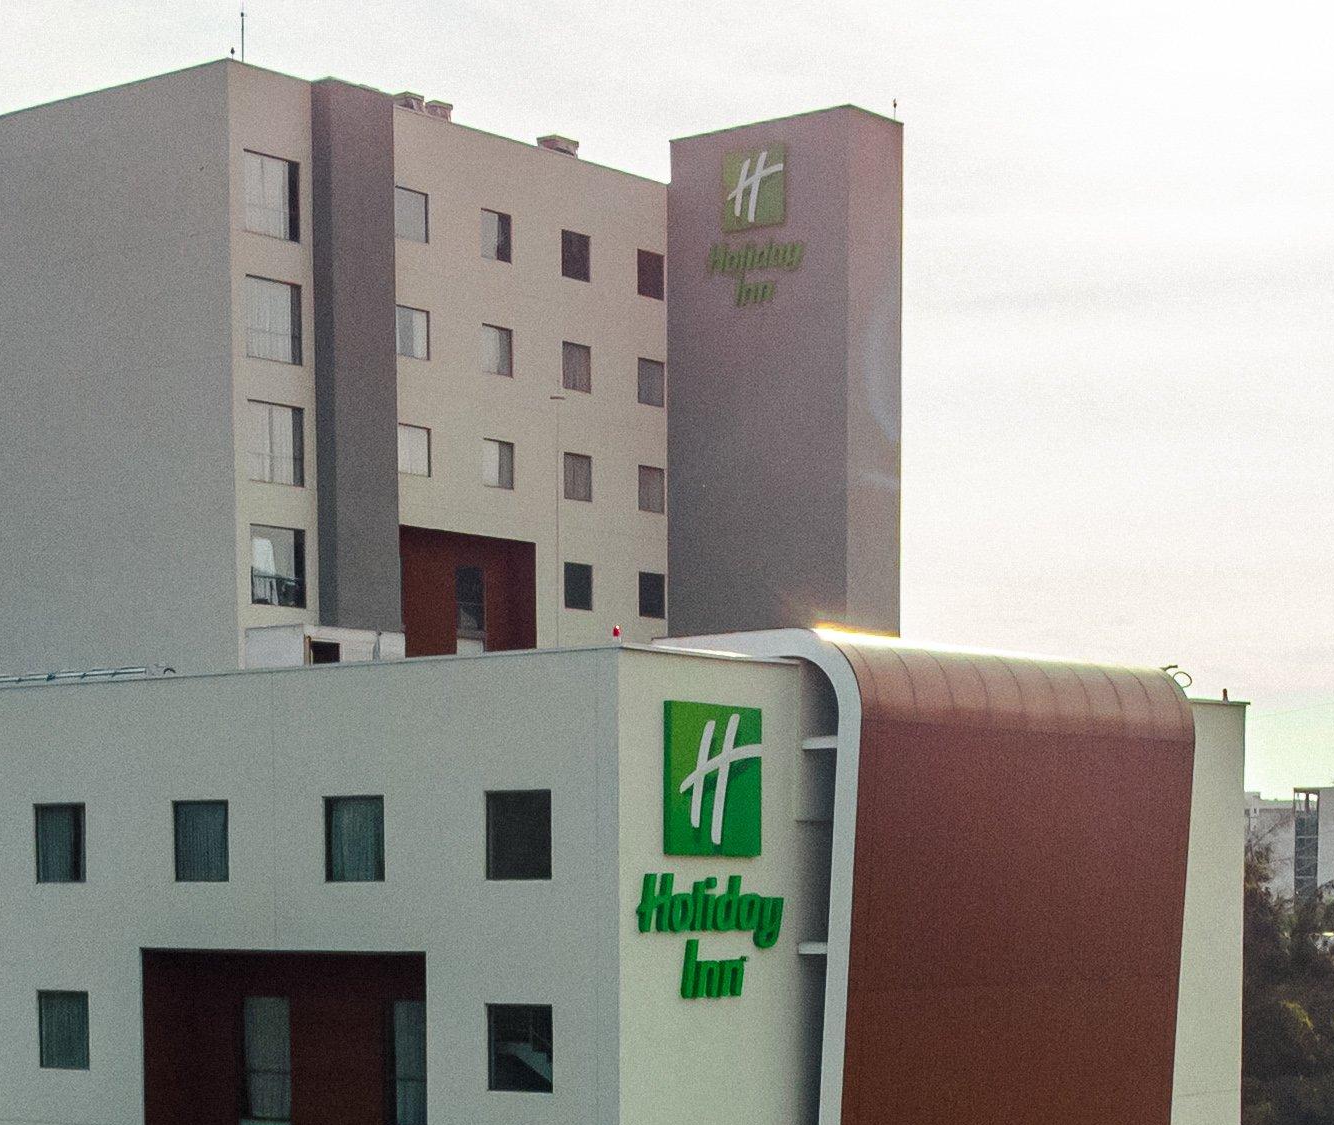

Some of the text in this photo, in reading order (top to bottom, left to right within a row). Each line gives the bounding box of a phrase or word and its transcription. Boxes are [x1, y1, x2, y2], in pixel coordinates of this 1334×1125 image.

[708, 241, 804, 275] Holiday
[735, 274, 776, 307] Inn
[636, 872, 785, 949] Holiday
[680, 938, 747, 999] Inn
